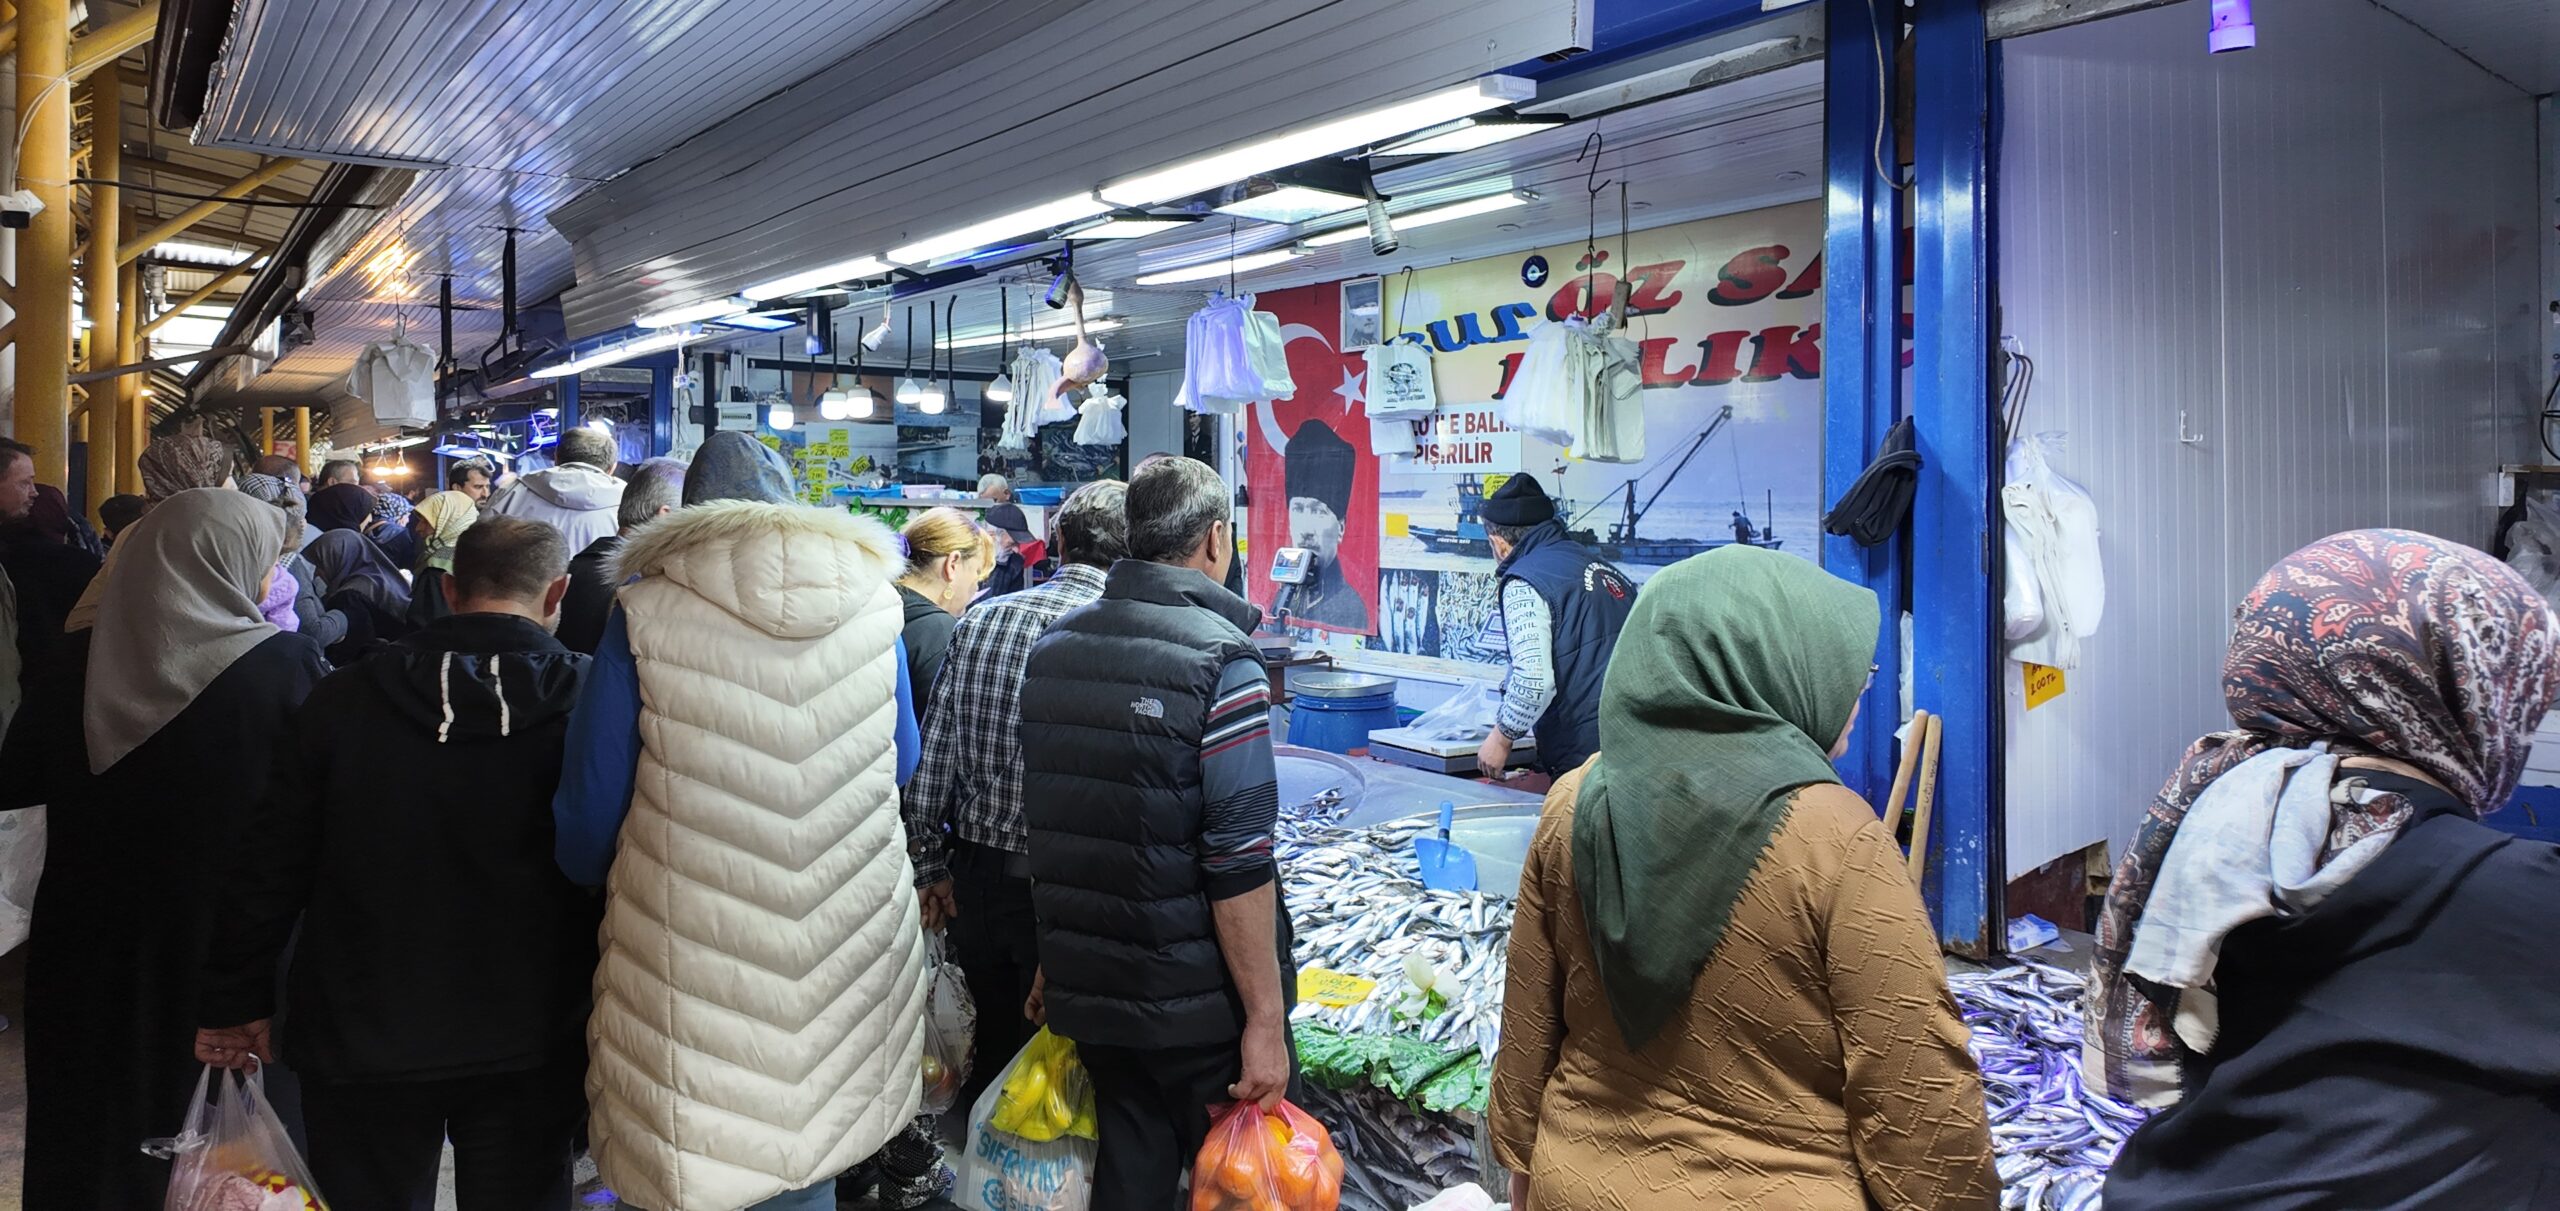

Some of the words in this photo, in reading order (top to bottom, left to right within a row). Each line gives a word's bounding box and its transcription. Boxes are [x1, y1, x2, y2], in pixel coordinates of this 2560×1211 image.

[1546, 250, 1685, 323] ÖZ
[1434, 408, 1460, 435] İE
[1465, 411, 1518, 434] BALI
[1130, 700, 1152, 710] NORTH
[1140, 696, 1153, 704] THE
[1134, 707, 1152, 716] FACE
